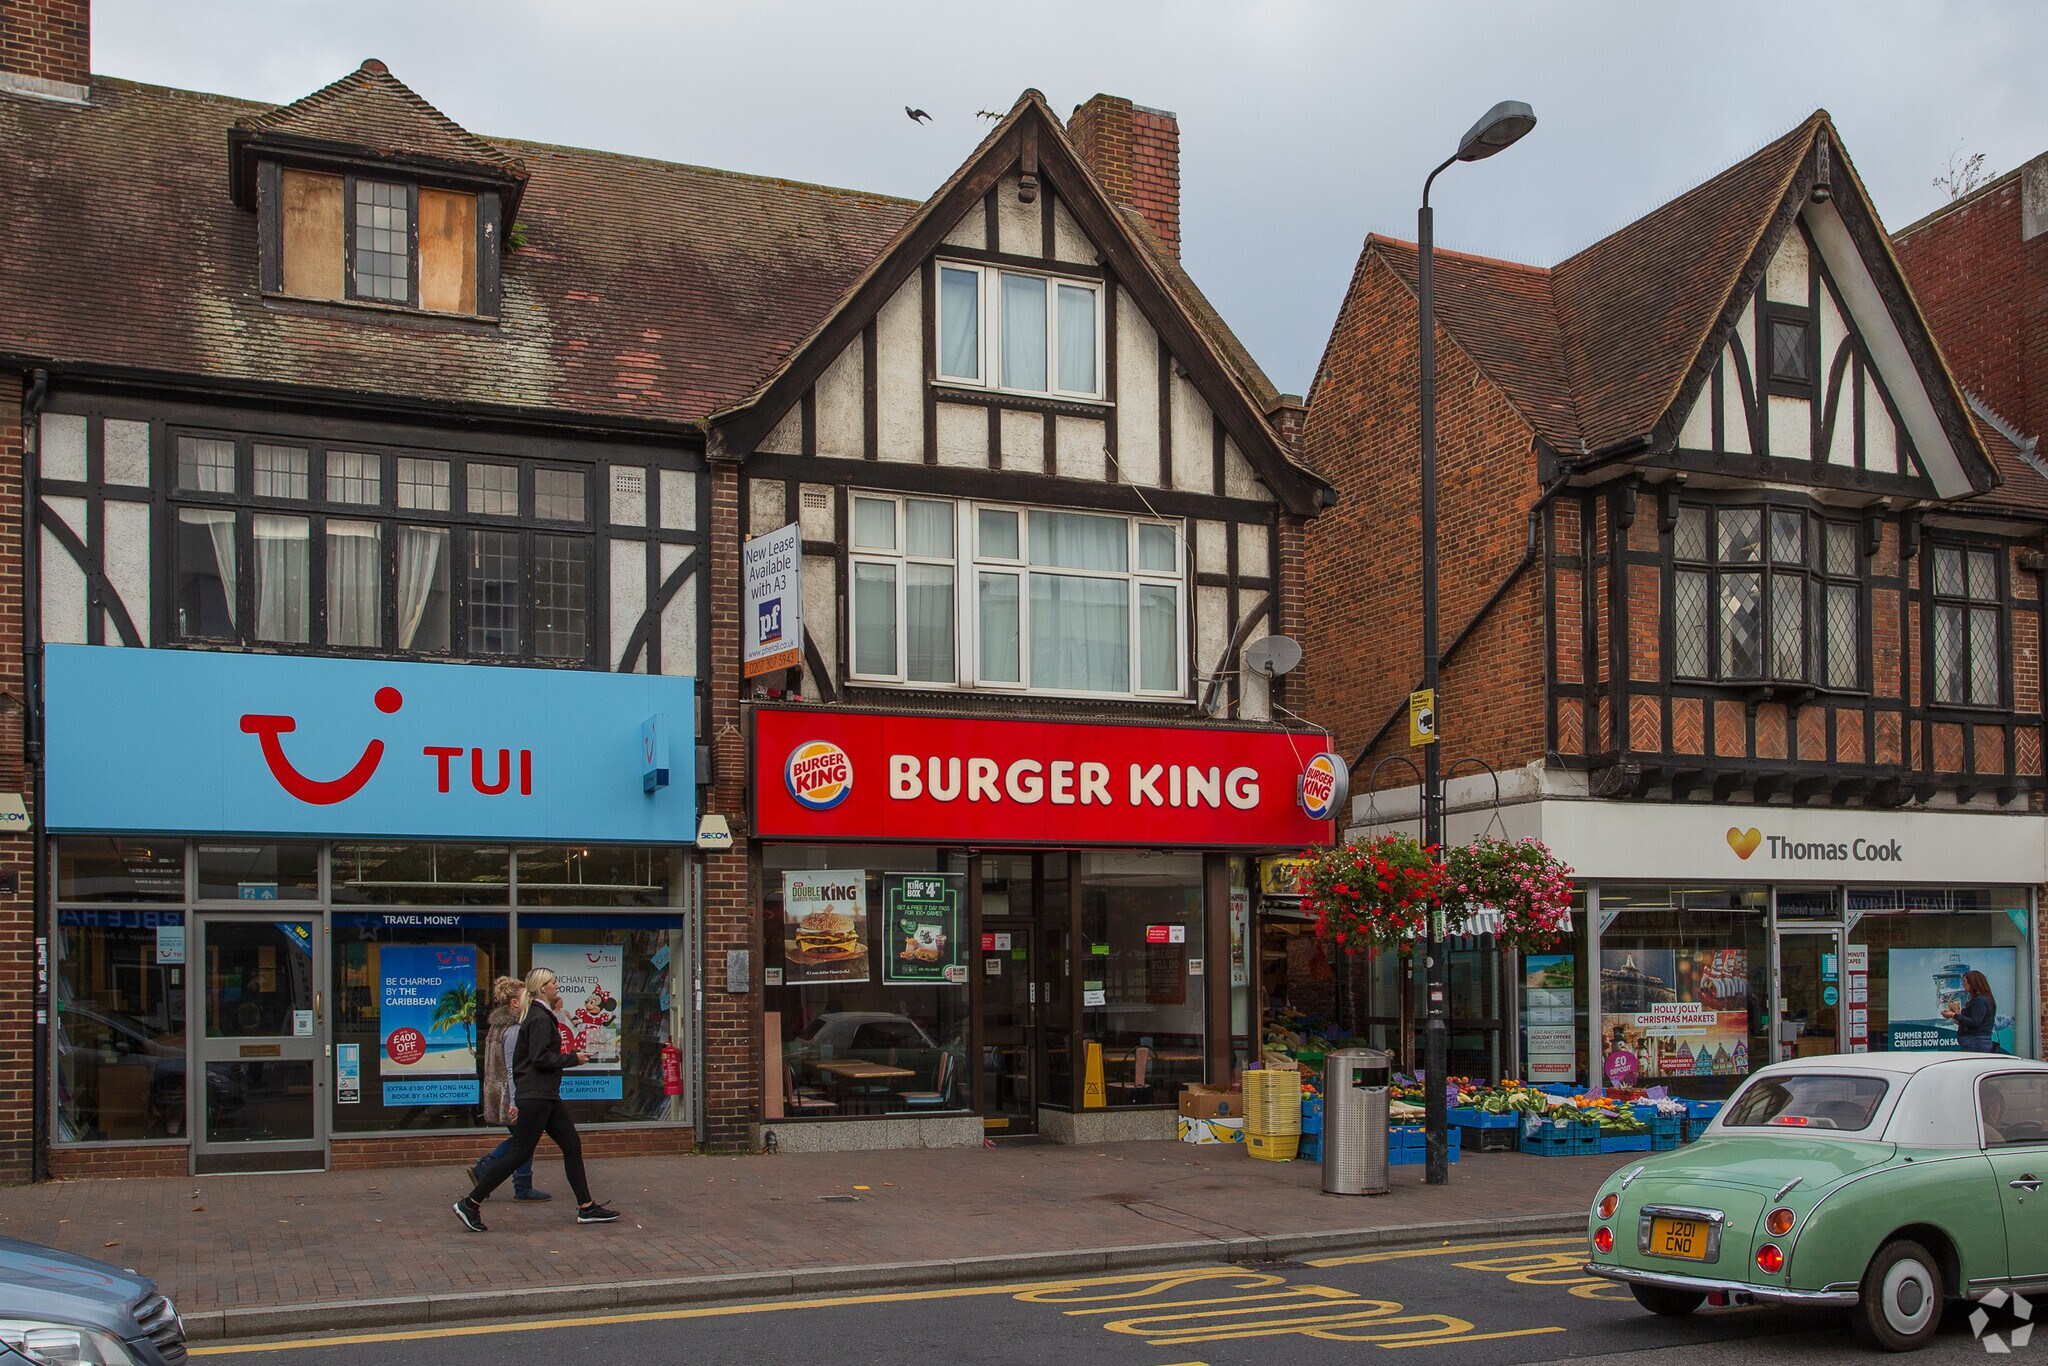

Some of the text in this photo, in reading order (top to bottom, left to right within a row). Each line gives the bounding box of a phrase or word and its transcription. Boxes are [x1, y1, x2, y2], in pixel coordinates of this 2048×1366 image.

[745, 536, 795, 565] New Lease
[749, 554, 791, 582] Available
[751, 574, 787, 599] with A3
[760, 604, 780, 641] pf
[749, 652, 794, 675] 0207 307 5943
[423, 746, 532, 796] TUI
[793, 753, 845, 777] BURGER
[796, 765, 847, 794] KING
[888, 754, 1260, 810] BURGER KING
[1306, 767, 1334, 787] BURGER
[1302, 779, 1331, 801] KING
[1767, 836, 1903, 861] Thomas Cook
[792, 883, 856, 901] DOUBLE KING
[907, 881, 924, 890] KING
[907, 889, 921, 897] BOX
[383, 915, 460, 925] TRAVEL MONEY
[386, 977, 442, 986] BE CHARMED
[555, 976, 599, 984] NCHANTED
[398, 987, 417, 995] THE
[386, 998, 437, 1006] CARIBBEAN
[1654, 1004, 1700, 1014] HOLLY JOLLY
[1637, 1014, 1715, 1024] CHRISTMAS MARKETS
[393, 1032, 417, 1044] £400
[1923, 1039, 1939, 1047] NOW
[396, 1041, 416, 1053] OFF
[1614, 1056, 1627, 1067] £0
[1610, 1064, 1631, 1075] DEPOSIT
[1666, 1221, 1696, 1237] J201
[1666, 1237, 1691, 1252] CNO
